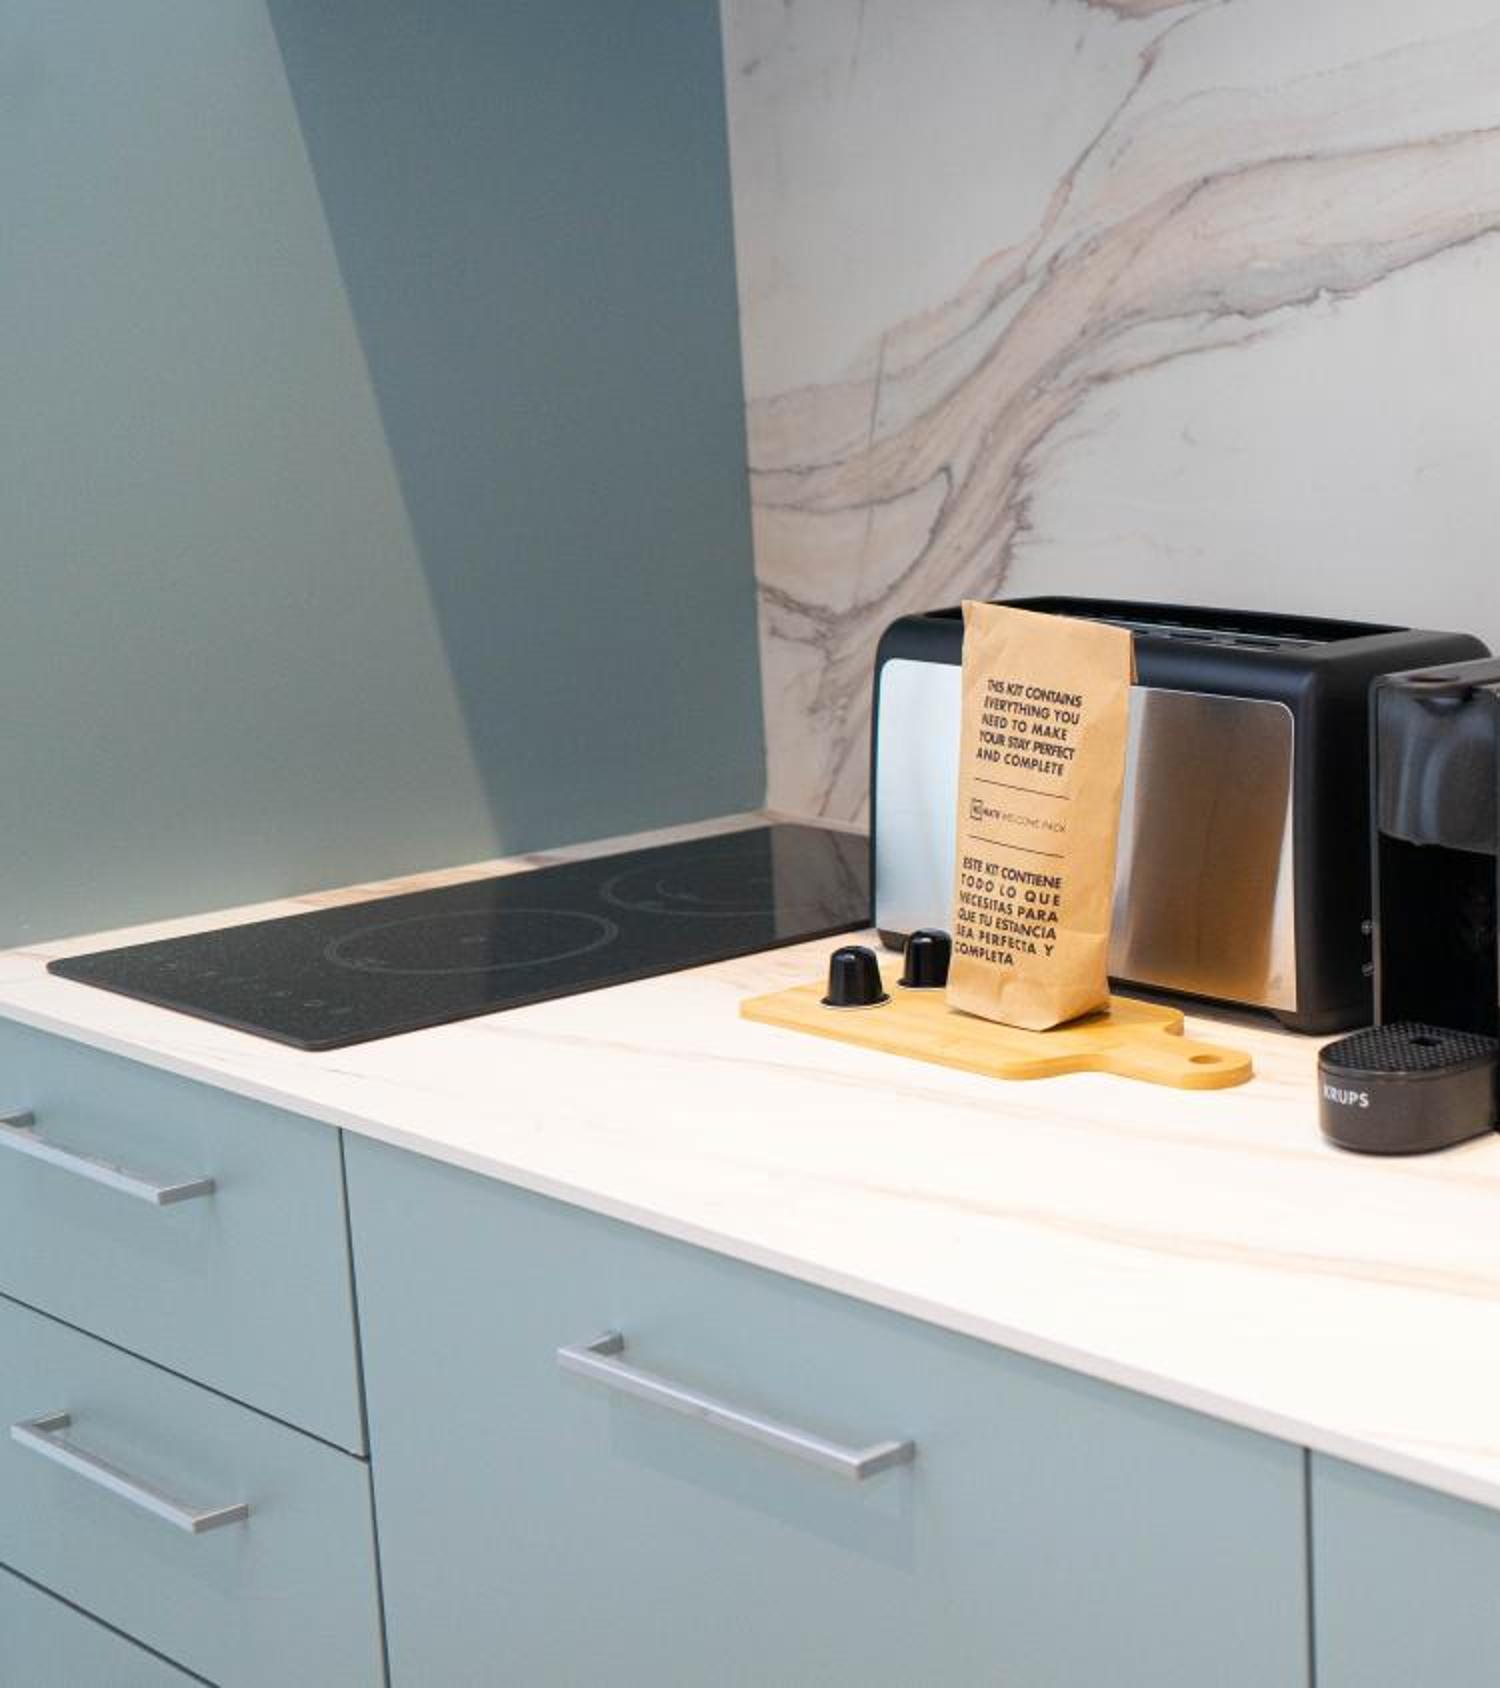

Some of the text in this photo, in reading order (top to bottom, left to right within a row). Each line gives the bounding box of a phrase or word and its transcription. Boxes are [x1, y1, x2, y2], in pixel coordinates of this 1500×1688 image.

[988, 679, 1082, 708] THIS KIT CONTAINS
[984, 696, 1080, 725] EVERYTHING YOU
[982, 713, 1068, 741] NEED TO MAKE
[979, 730, 1075, 760] YOUR STAY PERFECT
[976, 748, 1064, 776] AND COMPLETE
[963, 857, 1063, 889] ESTE KIT CONTIENE
[961, 873, 1061, 907] TODO LO QUE
[959, 890, 1059, 923] NECESITAS PARA
[958, 908, 1057, 940] QUE TU ESTANCIA
[955, 941, 1014, 966] COMPLETA
[979, 929, 1037, 955] PERFECTA
[1043, 944, 1055, 957] Y
[1324, 1084, 1370, 1108] KRUPS
